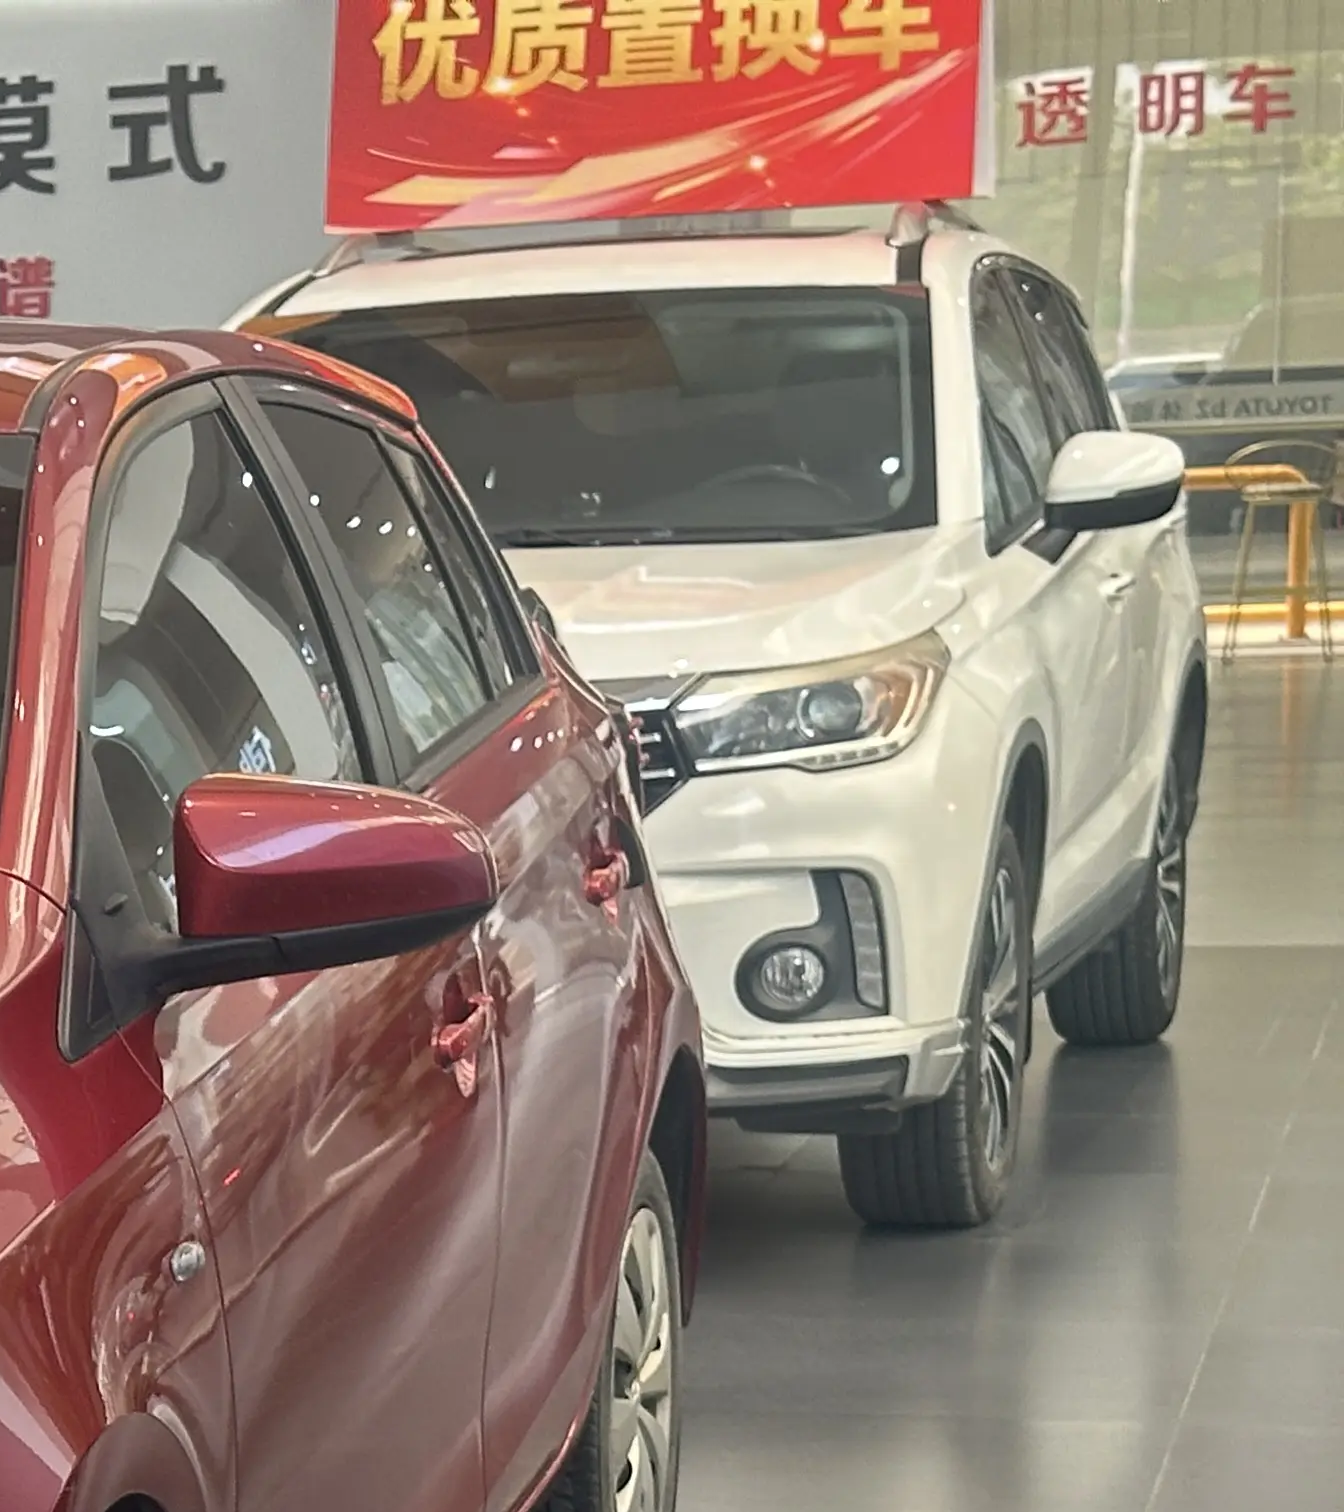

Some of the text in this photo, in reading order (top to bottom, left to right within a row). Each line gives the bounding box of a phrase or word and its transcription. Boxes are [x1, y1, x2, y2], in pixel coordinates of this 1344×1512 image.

[372, 0, 939, 105] 优质置换车
[1016, 62, 1296, 147] 透明车
